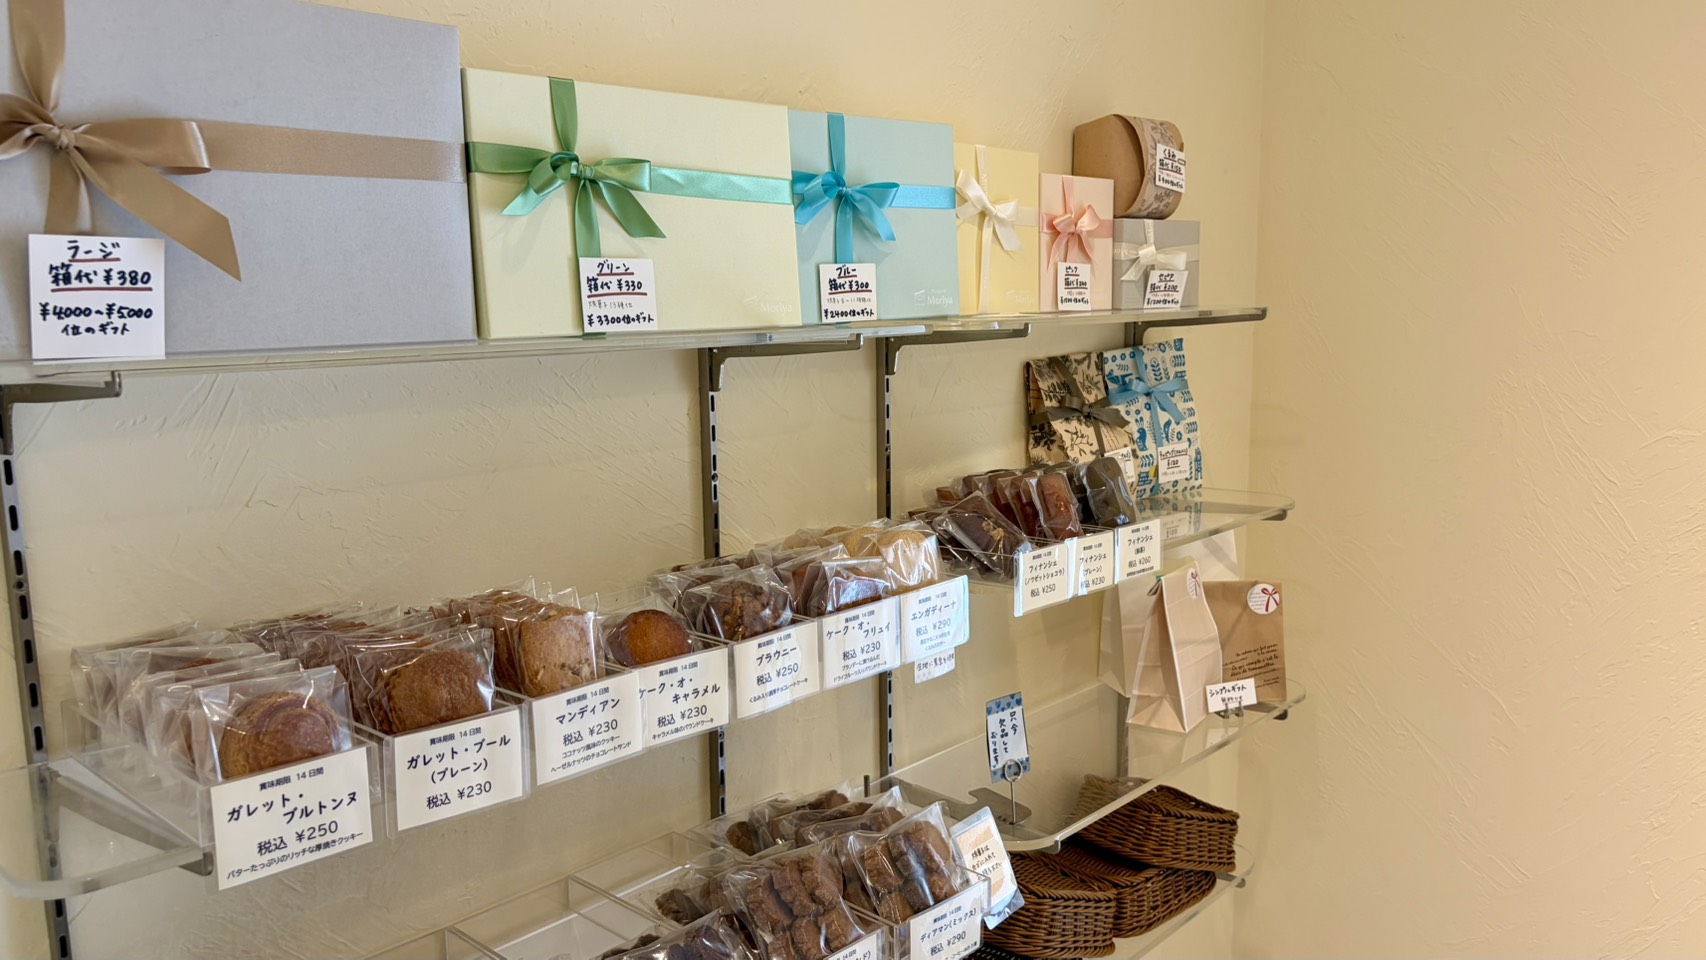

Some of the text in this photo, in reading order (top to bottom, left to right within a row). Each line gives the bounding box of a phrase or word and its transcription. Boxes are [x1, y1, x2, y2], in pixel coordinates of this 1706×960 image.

[67, 239, 120, 259] ラージ
[48, 262, 151, 286] 箱代 ¥380
[596, 259, 630, 274] グリーン
[836, 264, 857, 277] ブルー
[587, 276, 643, 293] 箱代 ¥330
[828, 278, 869, 291] 箱代 ¥300
[927, 295, 953, 308] Moriya
[61, 321, 130, 336] 位のギフト
[587, 312, 654, 327] ¥3300位のギフト
[1128, 535, 1154, 547] フィナンシェ
[1029, 560, 1058, 573] フィナンシェ
[1079, 553, 1107, 565] フィナンシェ
[1030, 583, 1056, 598] 税込 ¥250
[1092, 576, 1106, 586] ¥230
[911, 600, 957, 621] エンガディーナ
[826, 621, 870, 640] ケーク・オ・
[863, 621, 891, 639] フリュイ
[915, 618, 952, 637] 税込 ¥290
[756, 647, 797, 666] ブラウニー
[842, 640, 881, 661] 税込 ¥230
[658, 666, 679, 677] 賞味期限
[688, 661, 698, 669] 日間
[756, 662, 799, 686] 税込 ¥250
[566, 693, 587, 706] 賞味期限
[599, 687, 609, 696] 日間
[639, 676, 693, 699] ケーク・オ・
[672, 683, 721, 704] キャラメル
[556, 698, 620, 725] マンディアン
[657, 704, 708, 728] 税込 ¥230
[562, 719, 618, 747] 税込 ¥230
[652, 717, 714, 740] キャラメル味のパウンドケーキ
[1009, 710, 1019, 736] 只今
[429, 727, 482, 746] 賞味期限 14 日間
[998, 718, 1009, 753] 欠品して
[407, 734, 511, 770] ガレット・ブール
[550, 740, 632, 773] ヘーゼルナッツのチョコレートサンド
[562, 735, 620, 759] ココナッツ風味のクッキー
[259, 767, 325, 791] 賞味期限 14 日間
[431, 758, 489, 784] (プレーン)
[426, 781, 492, 810] 税込 ¥230
[227, 792, 304, 823] ガレット・
[283, 791, 357, 825] ブルトンヌ
[257, 820, 339, 856] 税込 ¥250
[227, 832, 364, 880] バターたっぷりのリッチな厚焼きクッキー
[920, 907, 977, 943] ディアマン(ミックス)
[930, 942, 944, 956] 税込
[946, 931, 967, 947] ¥290
